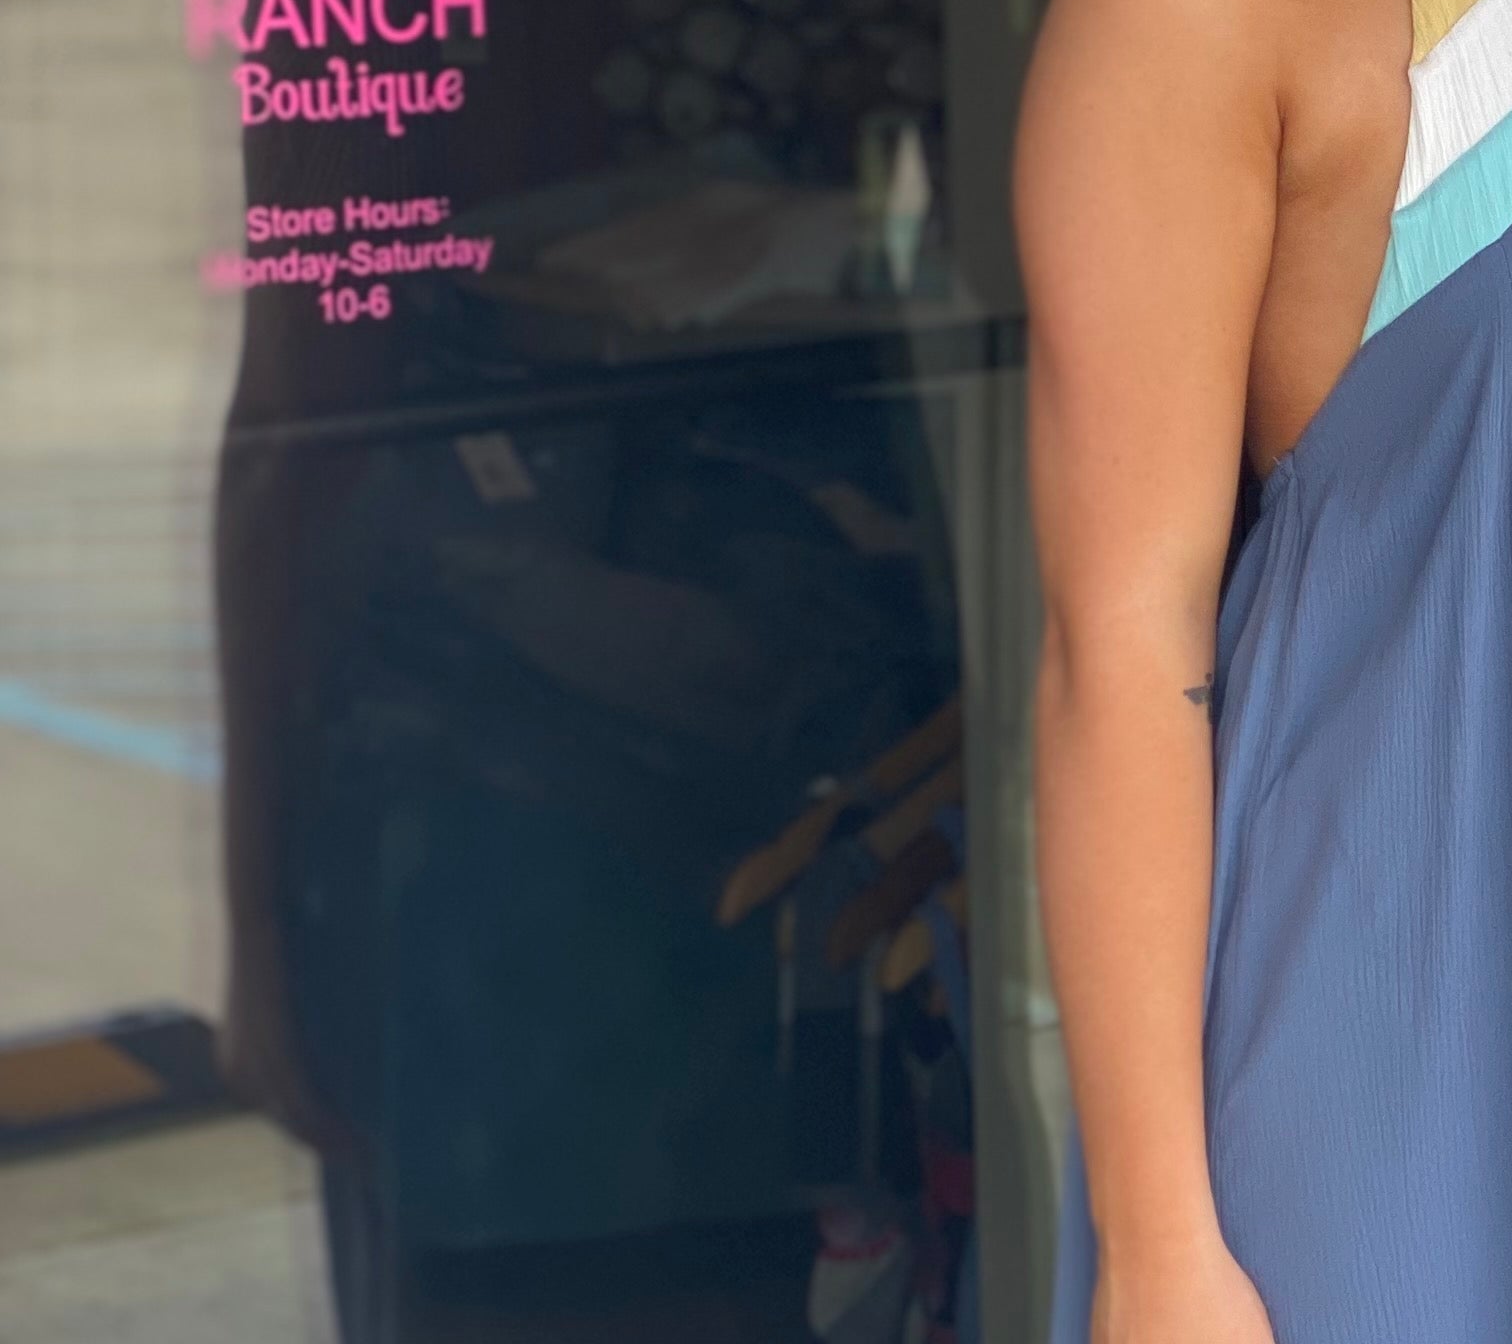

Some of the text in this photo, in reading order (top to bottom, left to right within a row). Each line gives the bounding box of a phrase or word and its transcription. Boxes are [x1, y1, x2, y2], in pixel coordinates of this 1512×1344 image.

[234, 58, 465, 137] Boutique
[246, 196, 450, 242] Store Hours:
[319, 284, 392, 323] 10-6
